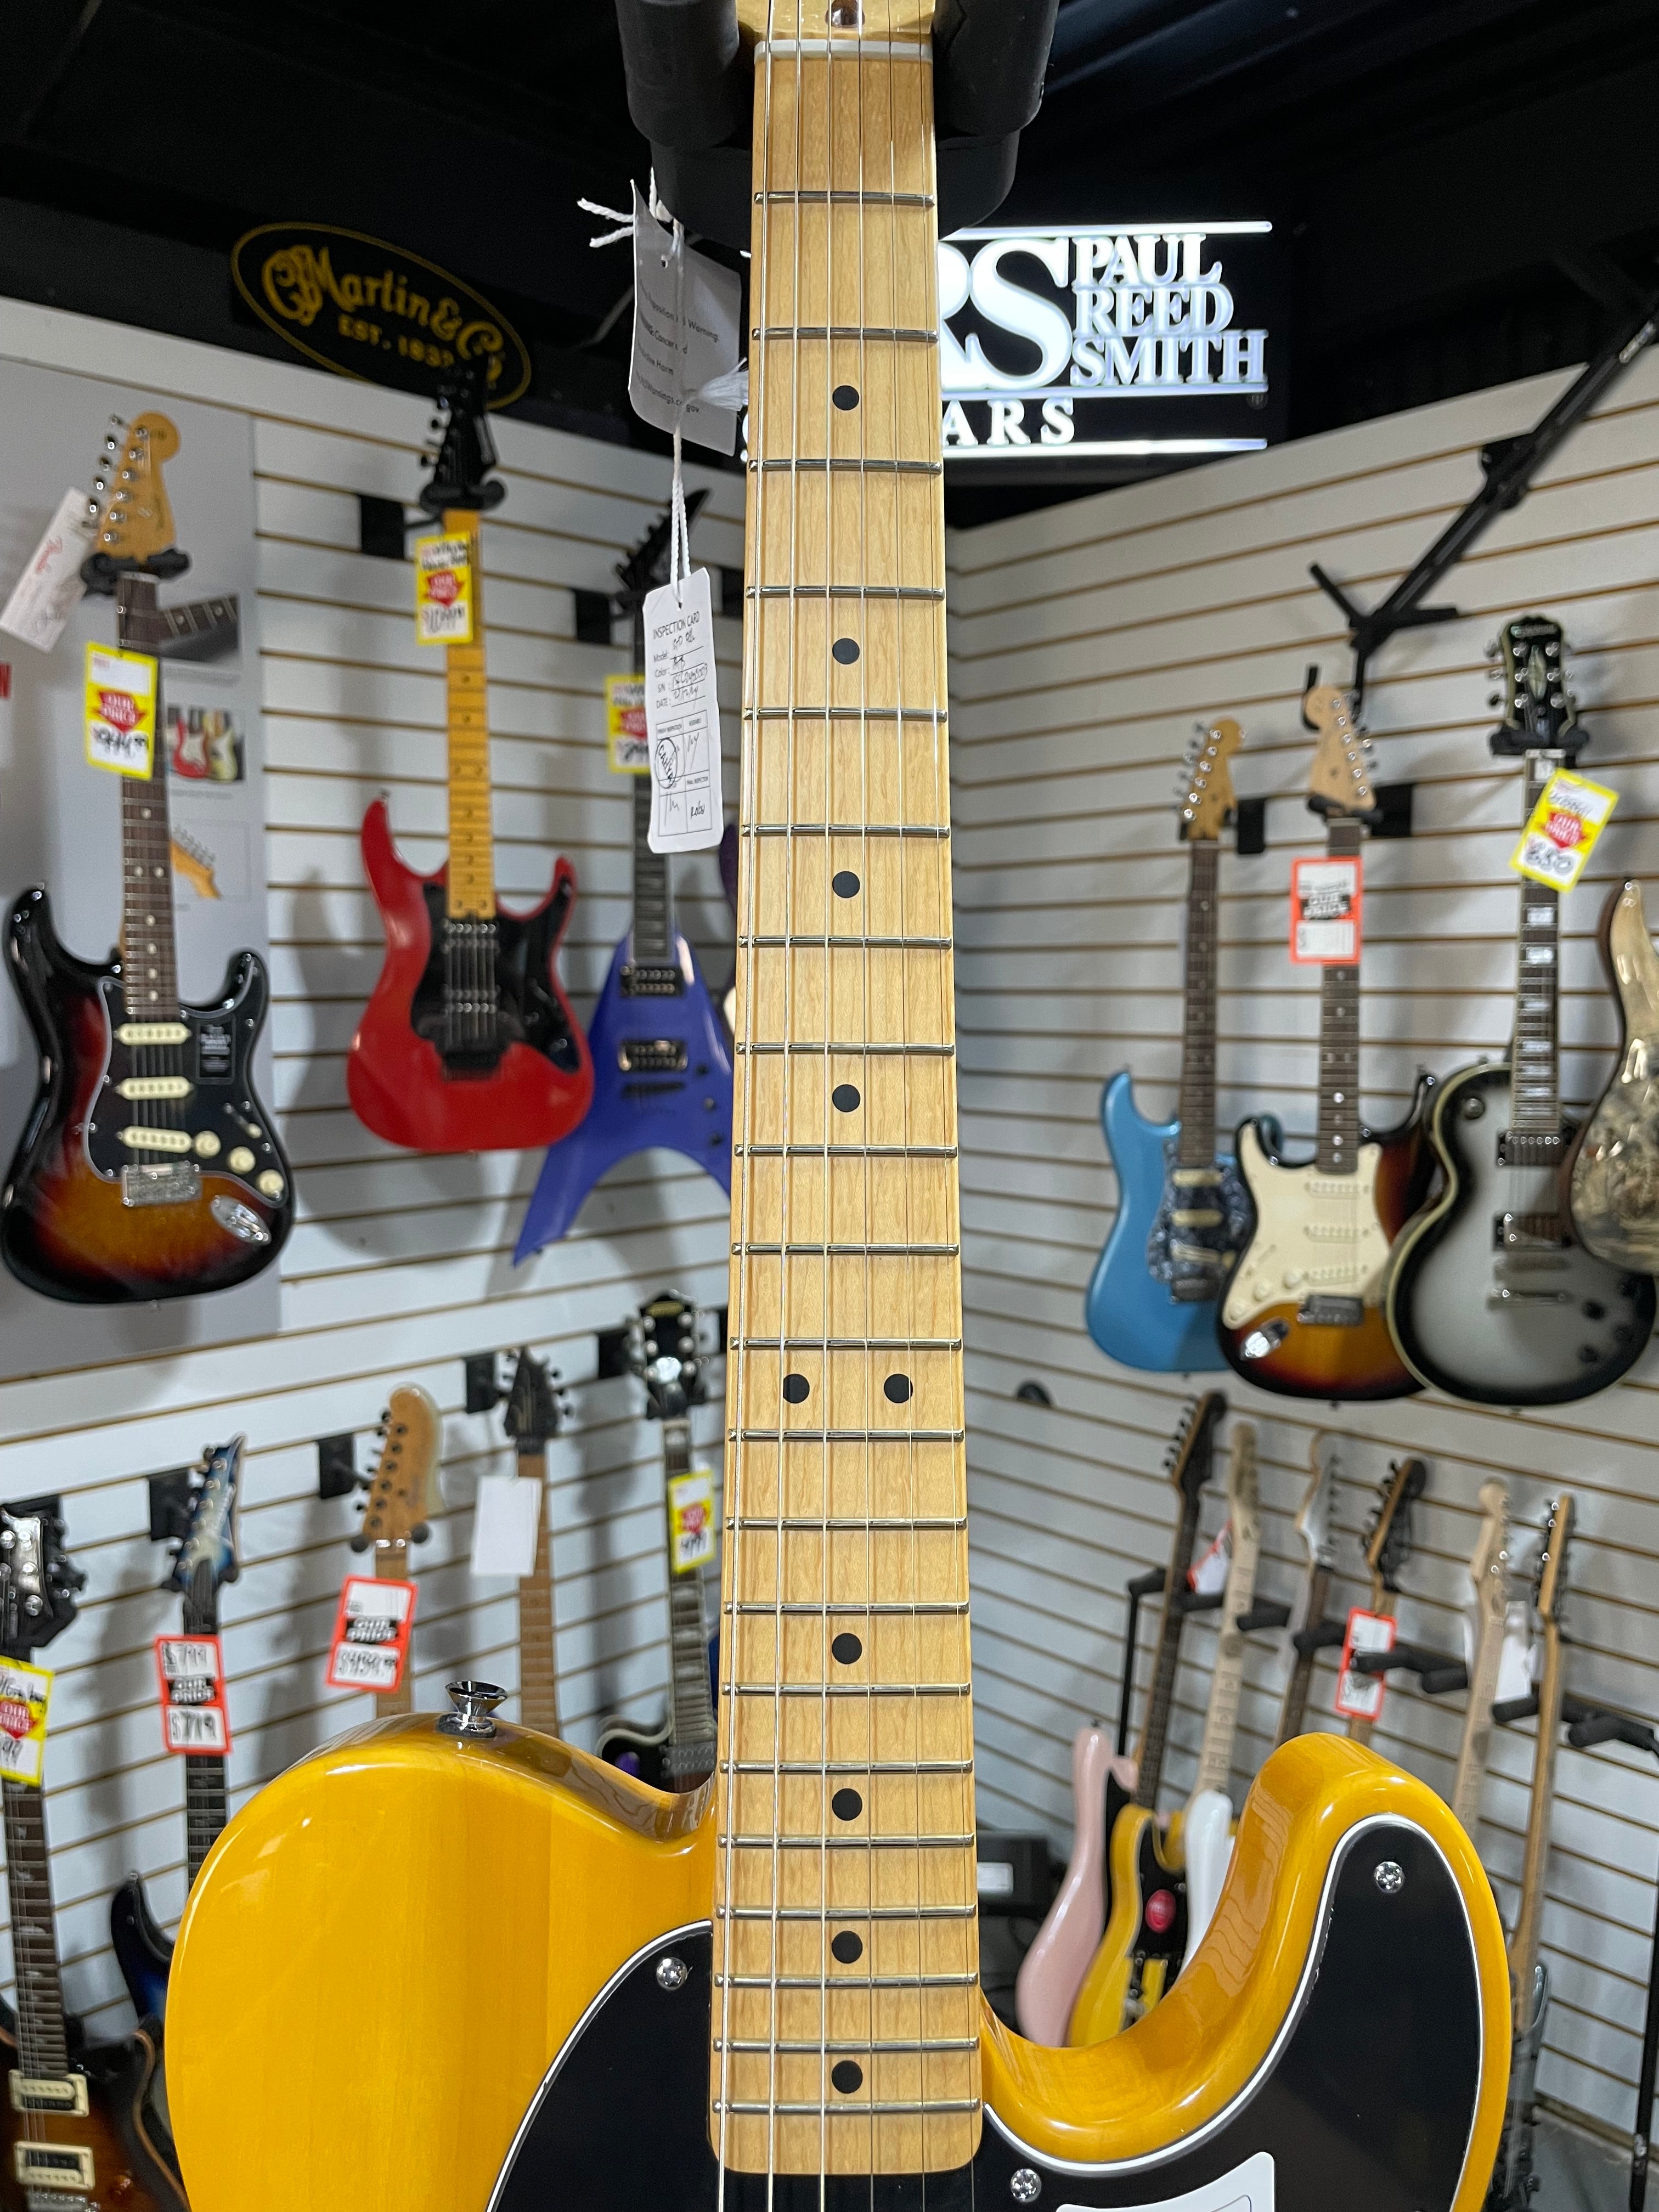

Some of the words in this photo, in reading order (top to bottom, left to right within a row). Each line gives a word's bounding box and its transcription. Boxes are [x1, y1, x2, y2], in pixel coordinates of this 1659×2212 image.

[1071, 233, 1222, 287] PAUL
[338, 314, 391, 350] EST.
[688, 318, 720, 344] Warning
[938, 238, 1073, 391] RS
[1073, 284, 1234, 336] REED
[656, 359, 674, 376] Harm
[1070, 330, 1269, 387] SMITH
[653, 619, 686, 640] INSPECTION
[687, 611, 700, 627] CARD
